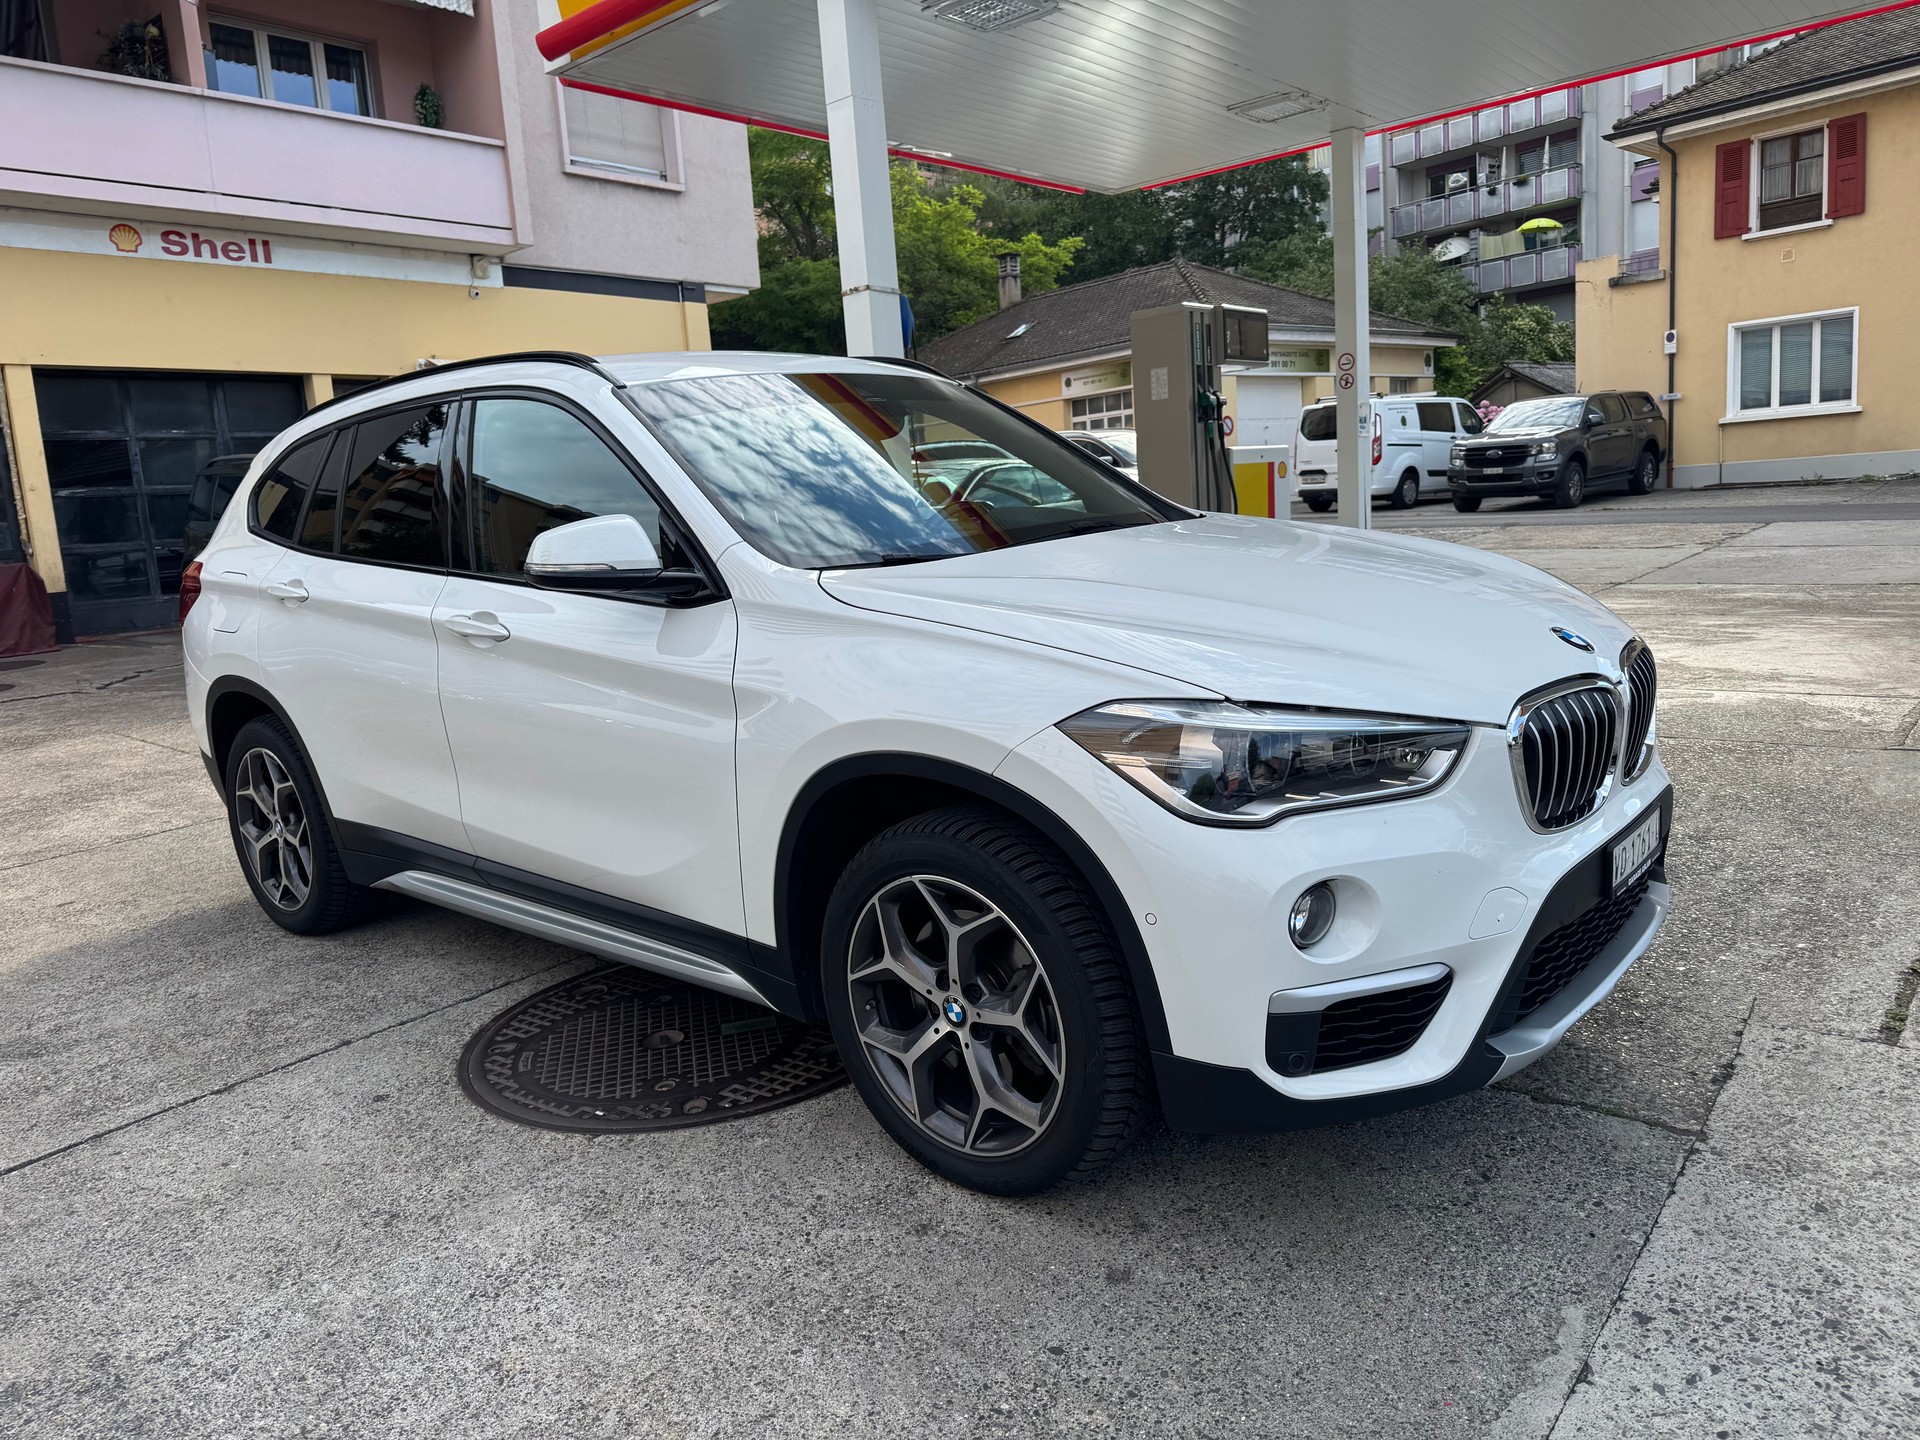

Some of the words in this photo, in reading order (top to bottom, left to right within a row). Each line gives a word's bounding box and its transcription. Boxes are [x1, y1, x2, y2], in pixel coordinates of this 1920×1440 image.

[161, 230, 272, 264] Shell
[1270, 360, 1281, 368] 981
[1281, 360, 1289, 368] 00
[1289, 360, 1296, 368] 71
